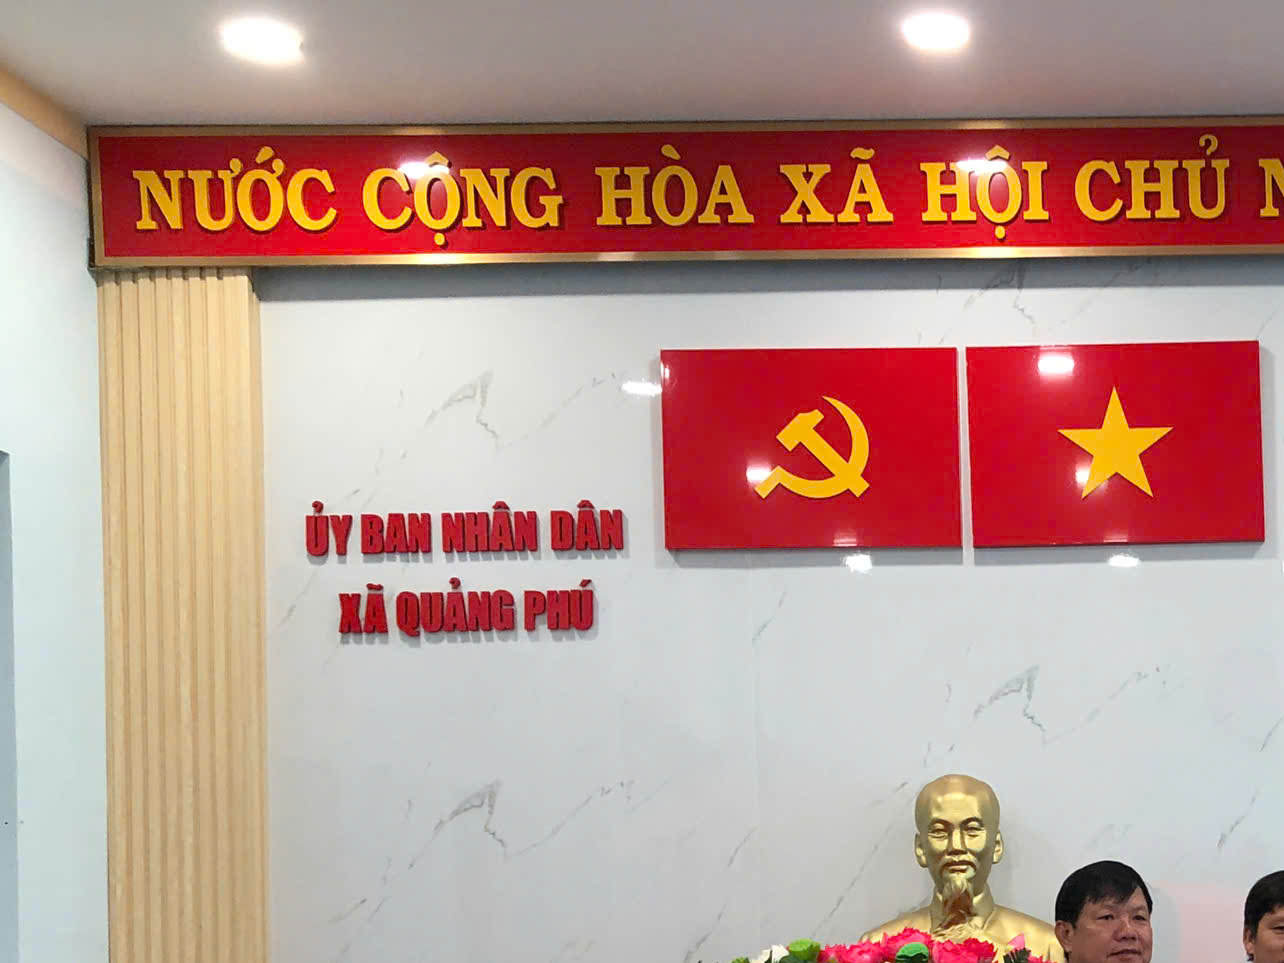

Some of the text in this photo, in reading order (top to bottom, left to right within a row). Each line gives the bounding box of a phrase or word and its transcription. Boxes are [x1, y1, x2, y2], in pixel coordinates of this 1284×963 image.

[132, 146, 338, 232] NƯỚC
[362, 151, 564, 246] CỘNG
[595, 144, 755, 226] HÒA
[779, 147, 895, 224] XÃ
[920, 145, 1050, 240] HỘI
[1074, 134, 1231, 222] CHỦ
[305, 500, 624, 556] ỦY BAN NHÂN DÂN
[338, 577, 594, 637] XÃ QUẢNG PHÚ
